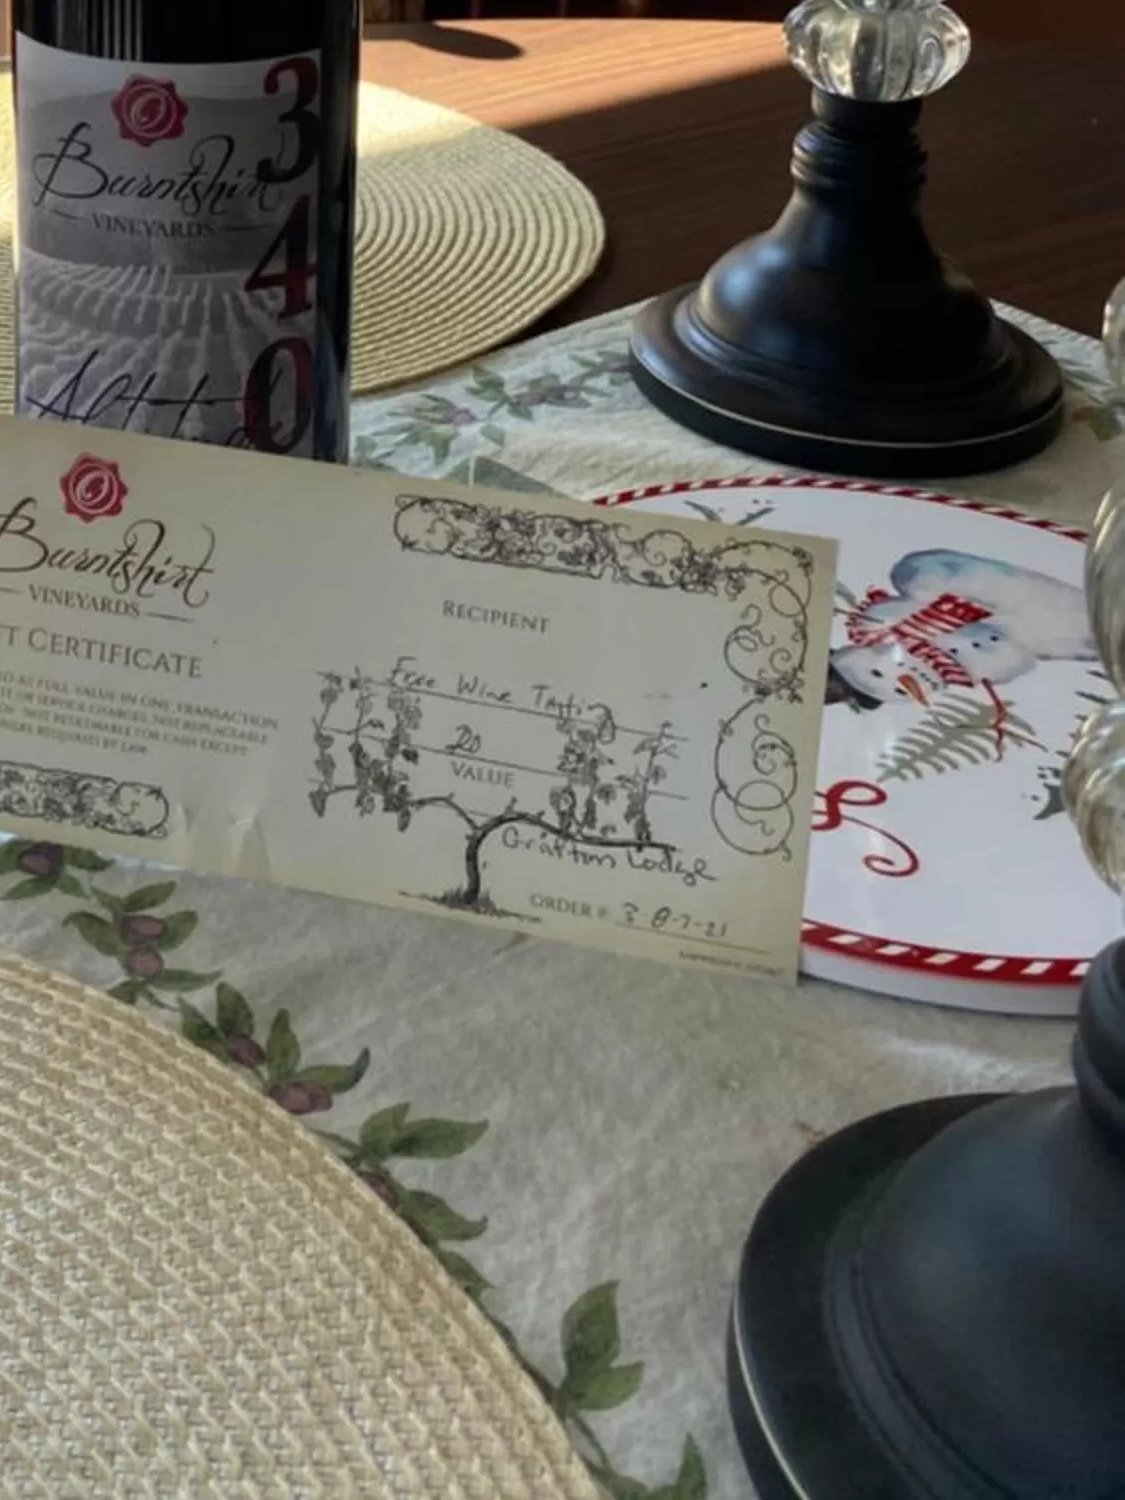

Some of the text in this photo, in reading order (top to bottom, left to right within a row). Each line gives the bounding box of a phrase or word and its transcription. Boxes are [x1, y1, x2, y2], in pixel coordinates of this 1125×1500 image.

[90, 211, 218, 238] VINEYARDS
[28, 583, 142, 619] VINEYARDS
[442, 599, 552, 635] RECIPIENT
[27, 626, 204, 680] CERTIFICATE
[450, 760, 516, 788] VALUE
[529, 892, 592, 918] ORDER
